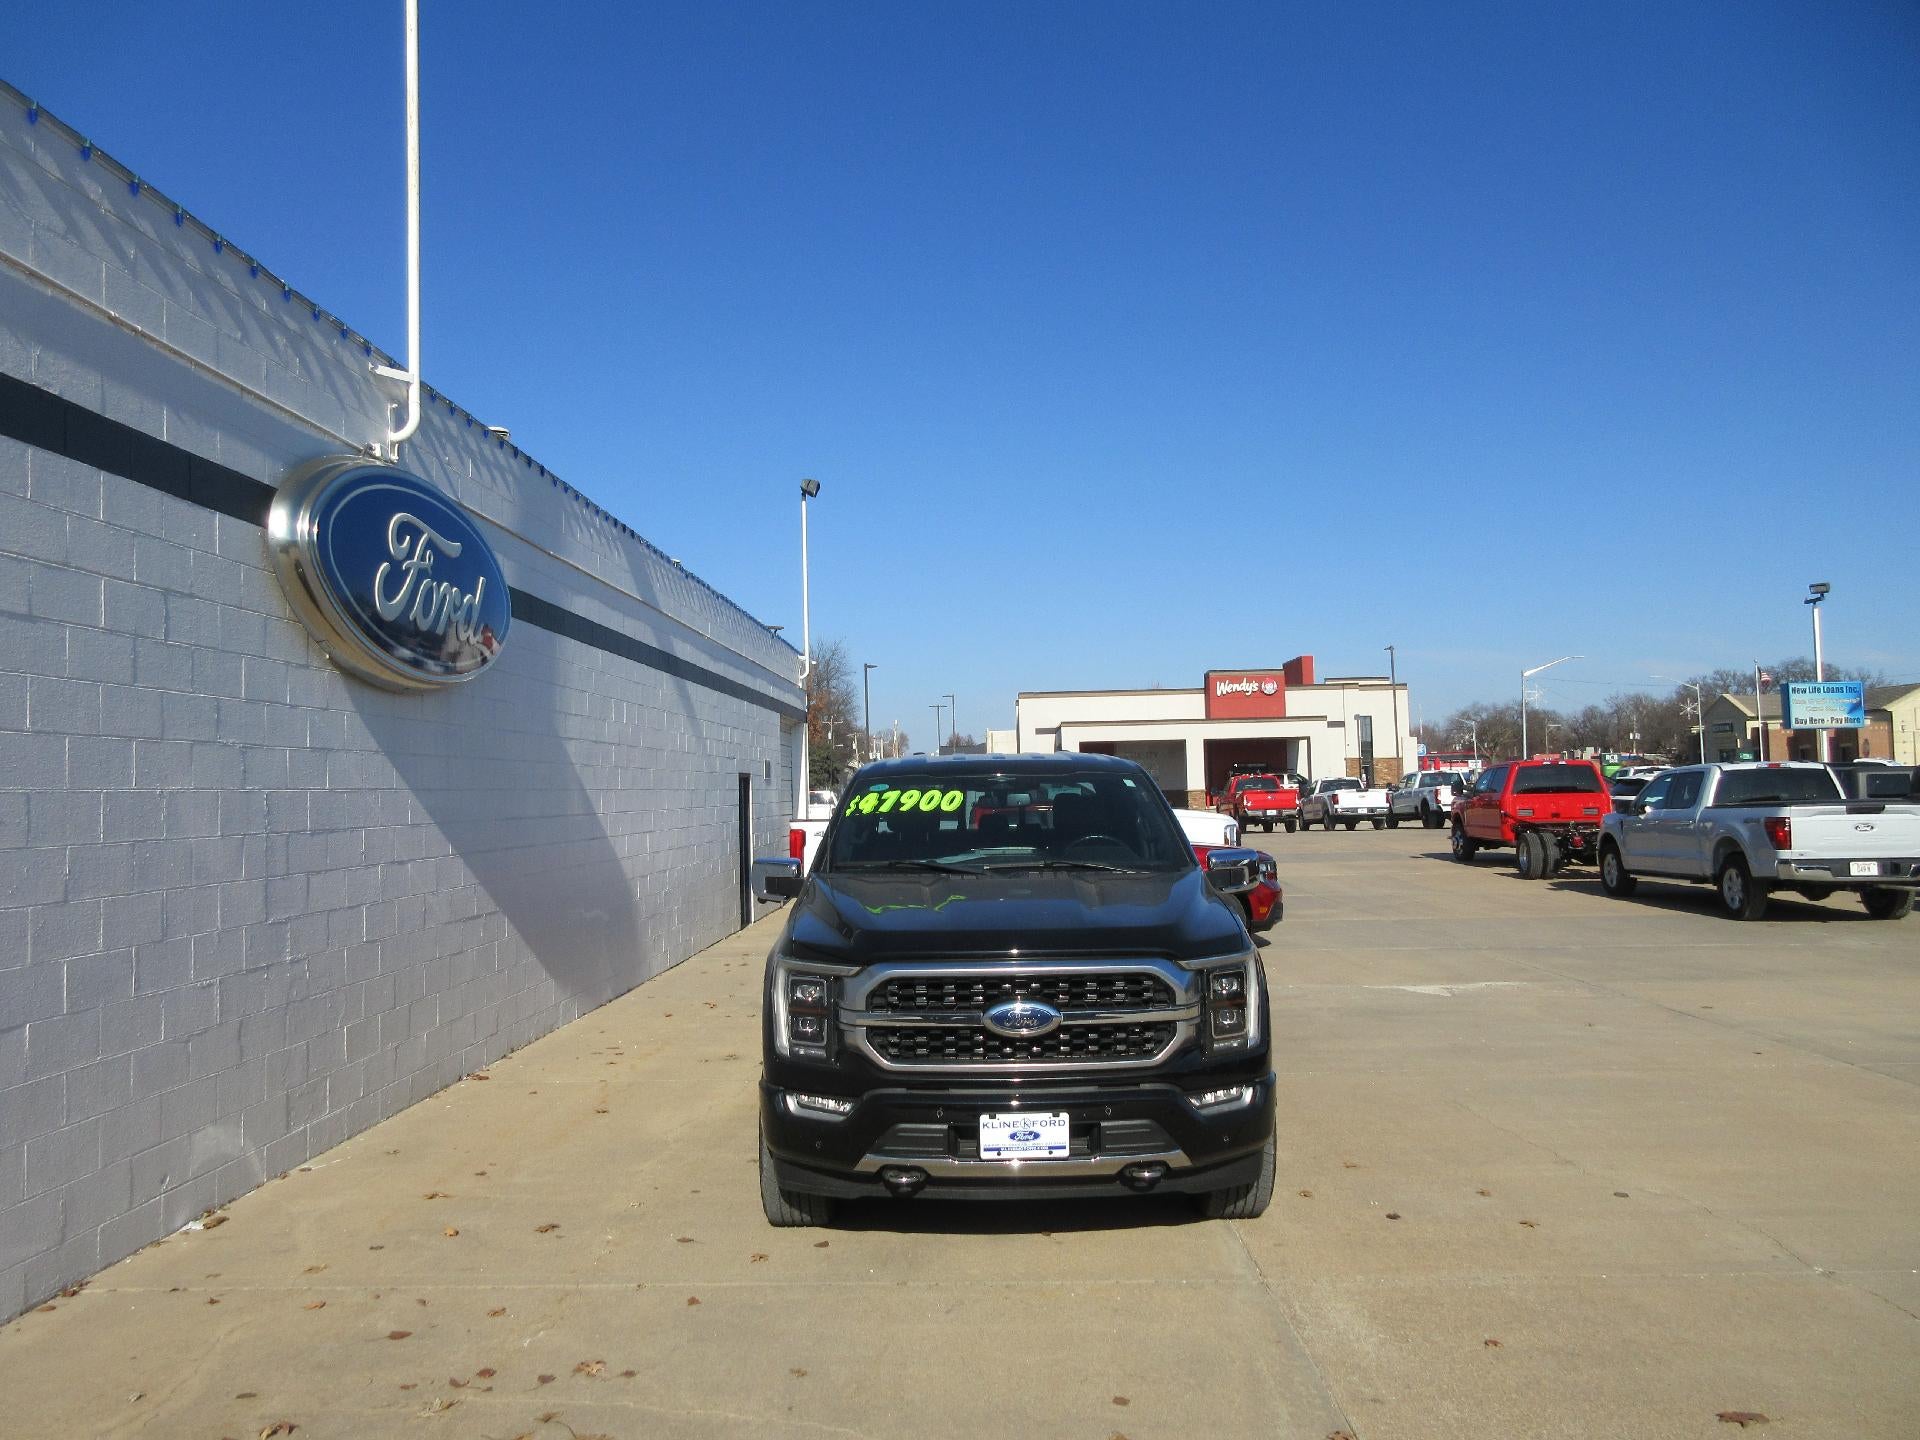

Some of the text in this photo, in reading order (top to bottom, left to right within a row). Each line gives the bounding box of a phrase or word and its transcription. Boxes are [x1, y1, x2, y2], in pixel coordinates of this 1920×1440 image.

[374, 512, 486, 643] Ford
[1216, 677, 1259, 696] Wendy's
[1808, 686, 1821, 694] Life
[1794, 717, 1807, 725] Buy
[1830, 716, 1843, 724] Pay
[845, 789, 964, 817] $47900
[1004, 1009, 1038, 1027] Ford
[982, 1120, 1019, 1129] KLINE
[1032, 1119, 1066, 1127] FORD
[1014, 1131, 1035, 1140] Ford
